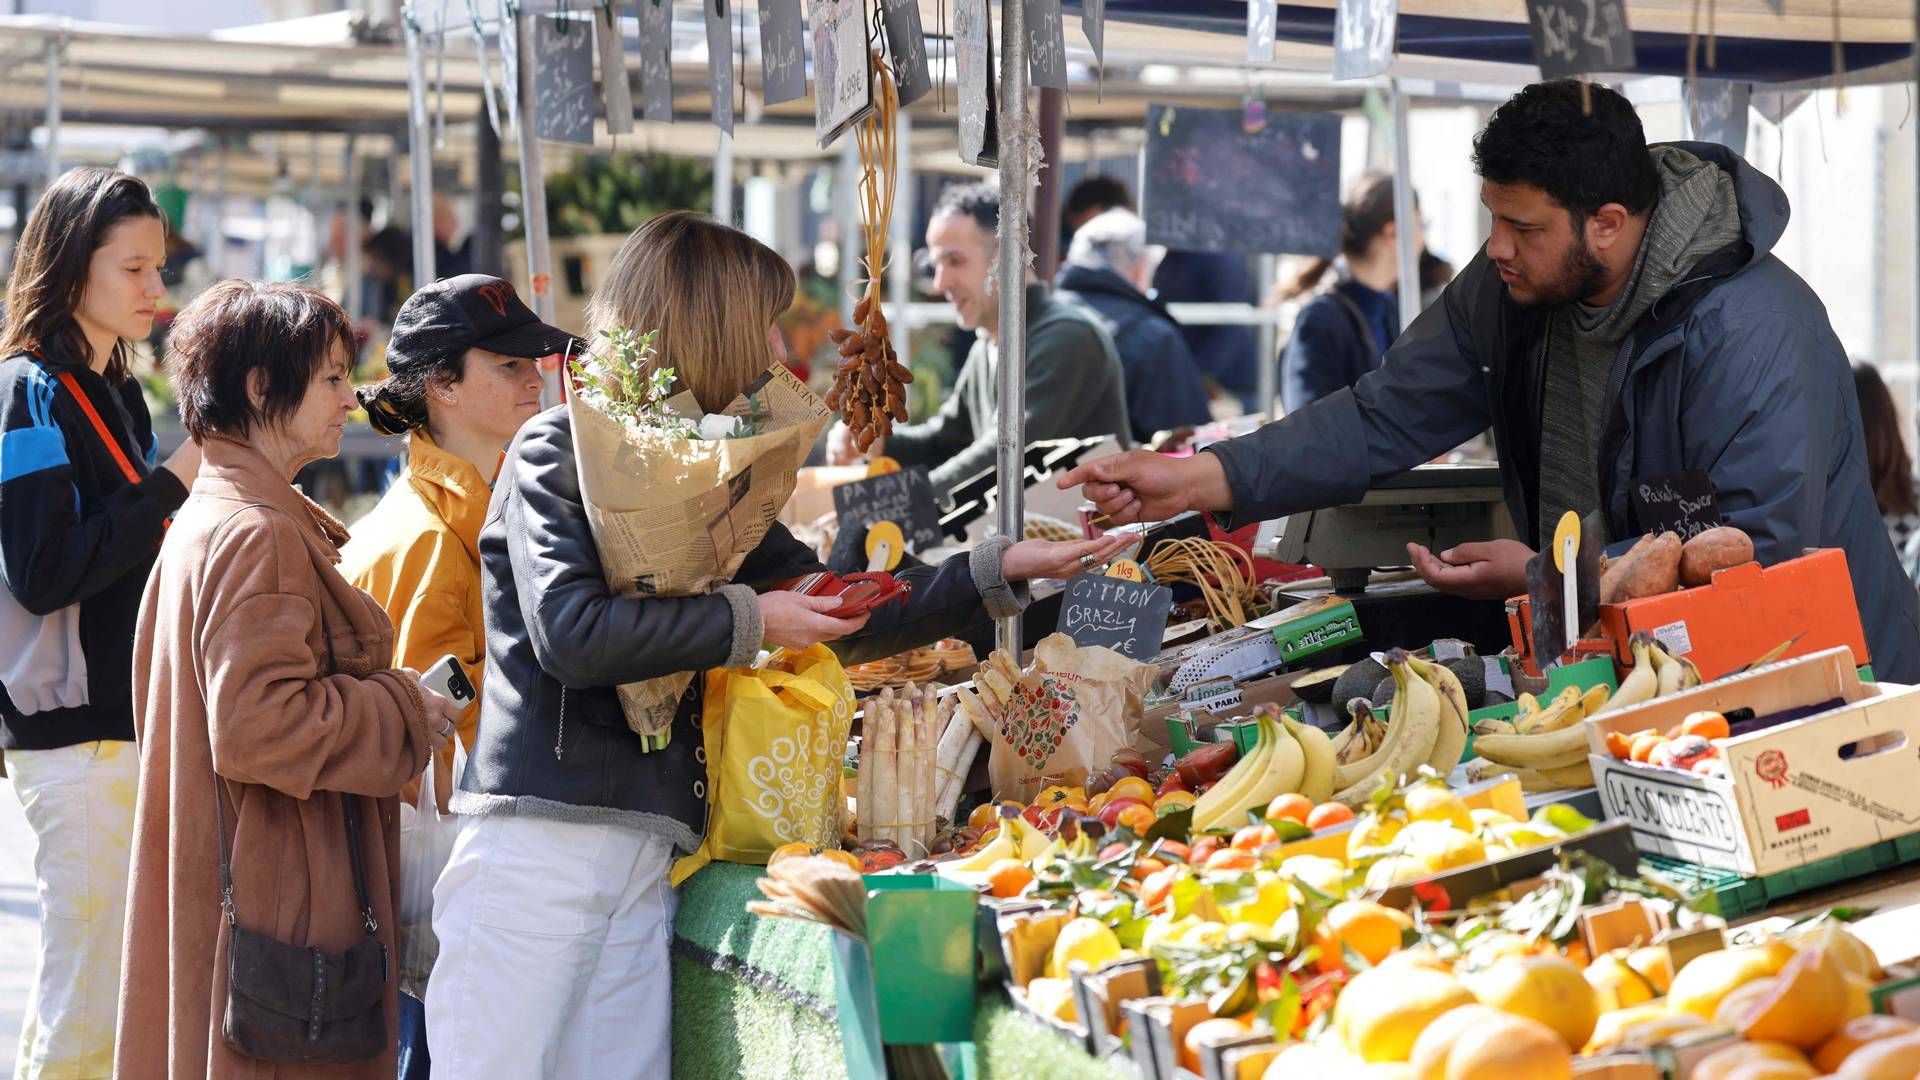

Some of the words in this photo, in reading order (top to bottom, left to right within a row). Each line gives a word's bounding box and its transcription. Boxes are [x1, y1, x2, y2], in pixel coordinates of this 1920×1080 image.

[840, 69, 863, 105] 4,99€
[1116, 562, 1133, 579] 1kg
[1190, 685, 1231, 701] Limes
[1608, 779, 1638, 820] LA
